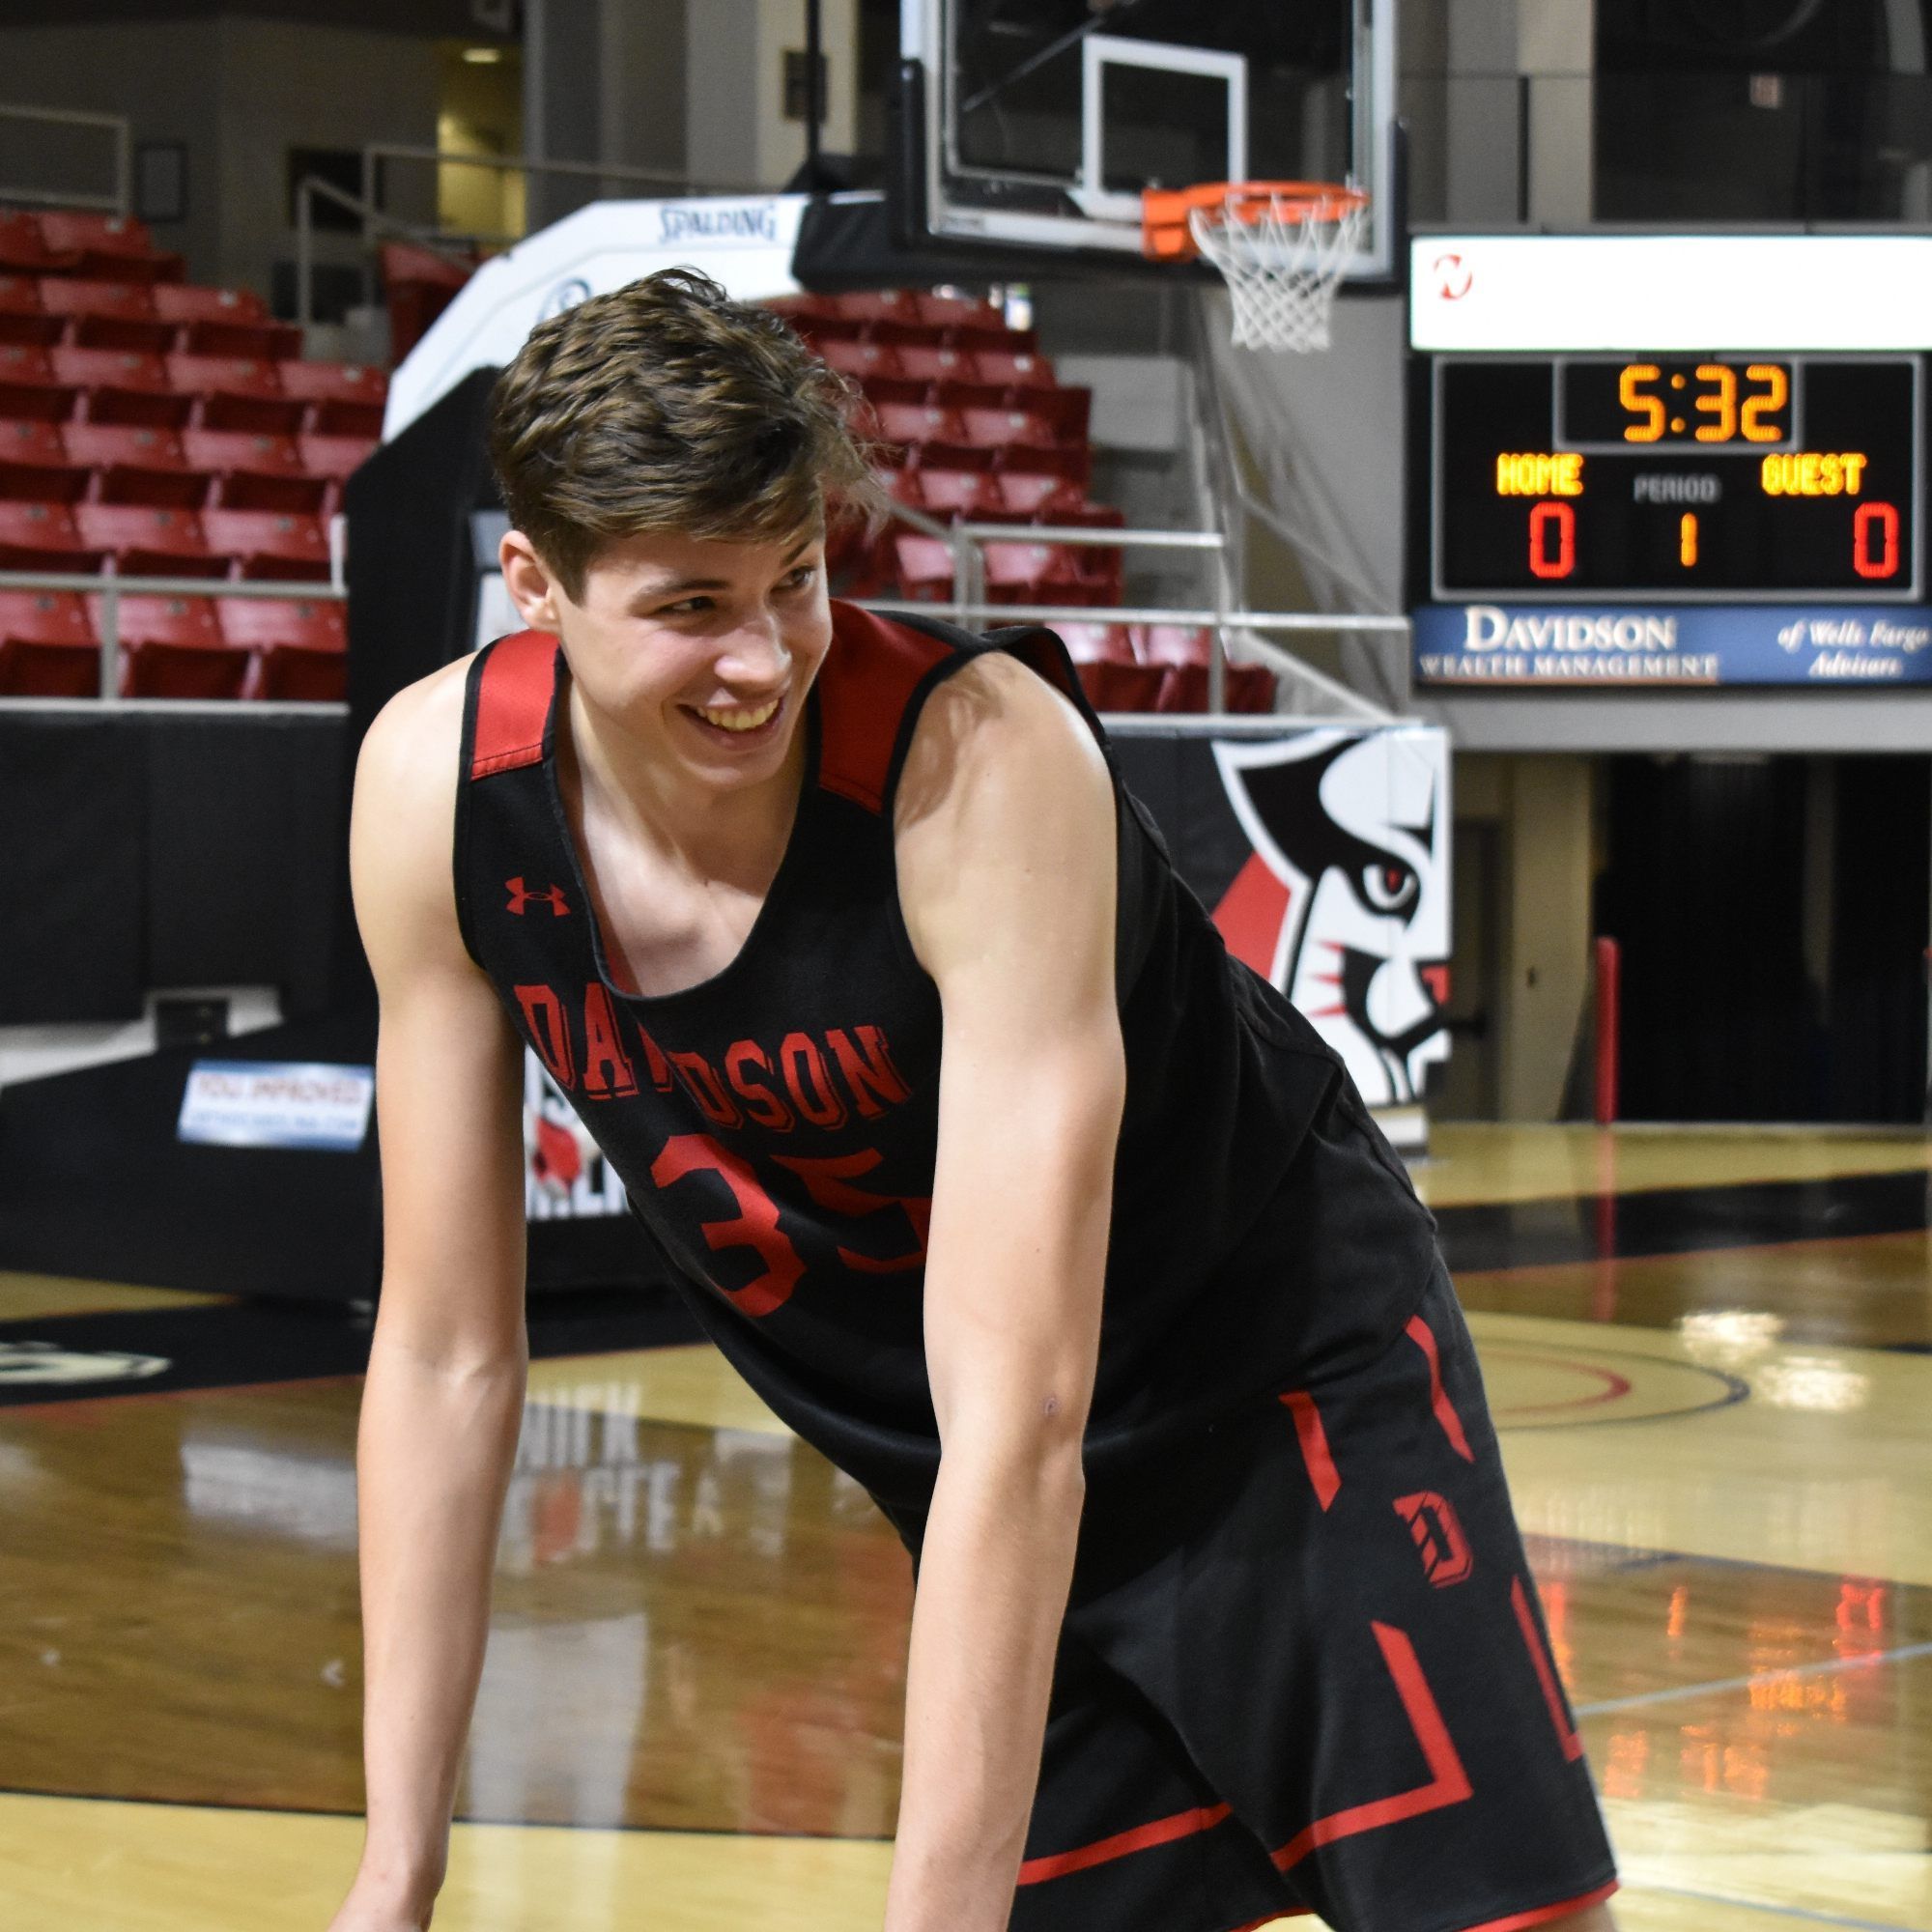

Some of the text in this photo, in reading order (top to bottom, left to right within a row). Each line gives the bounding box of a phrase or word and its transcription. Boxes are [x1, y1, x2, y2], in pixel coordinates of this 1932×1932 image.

[658, 201, 778, 244] SPALDING
[1619, 364, 1788, 442] 5:32
[1496, 453, 1584, 496] HOME
[1634, 472, 1720, 503] PERIOD
[1761, 453, 1867, 496] GUEST
[1529, 501, 1576, 579] 0
[1681, 512, 1698, 567] 1
[1854, 501, 1899, 579] 0
[1464, 605, 1678, 652] DAVIDSON
[1777, 617, 1930, 654] of Wells Fargo
[1419, 653, 1719, 677] WEALTH MANAGEMENT
[514, 981, 913, 1133] DADSON
[650, 1134, 932, 1318] 35
